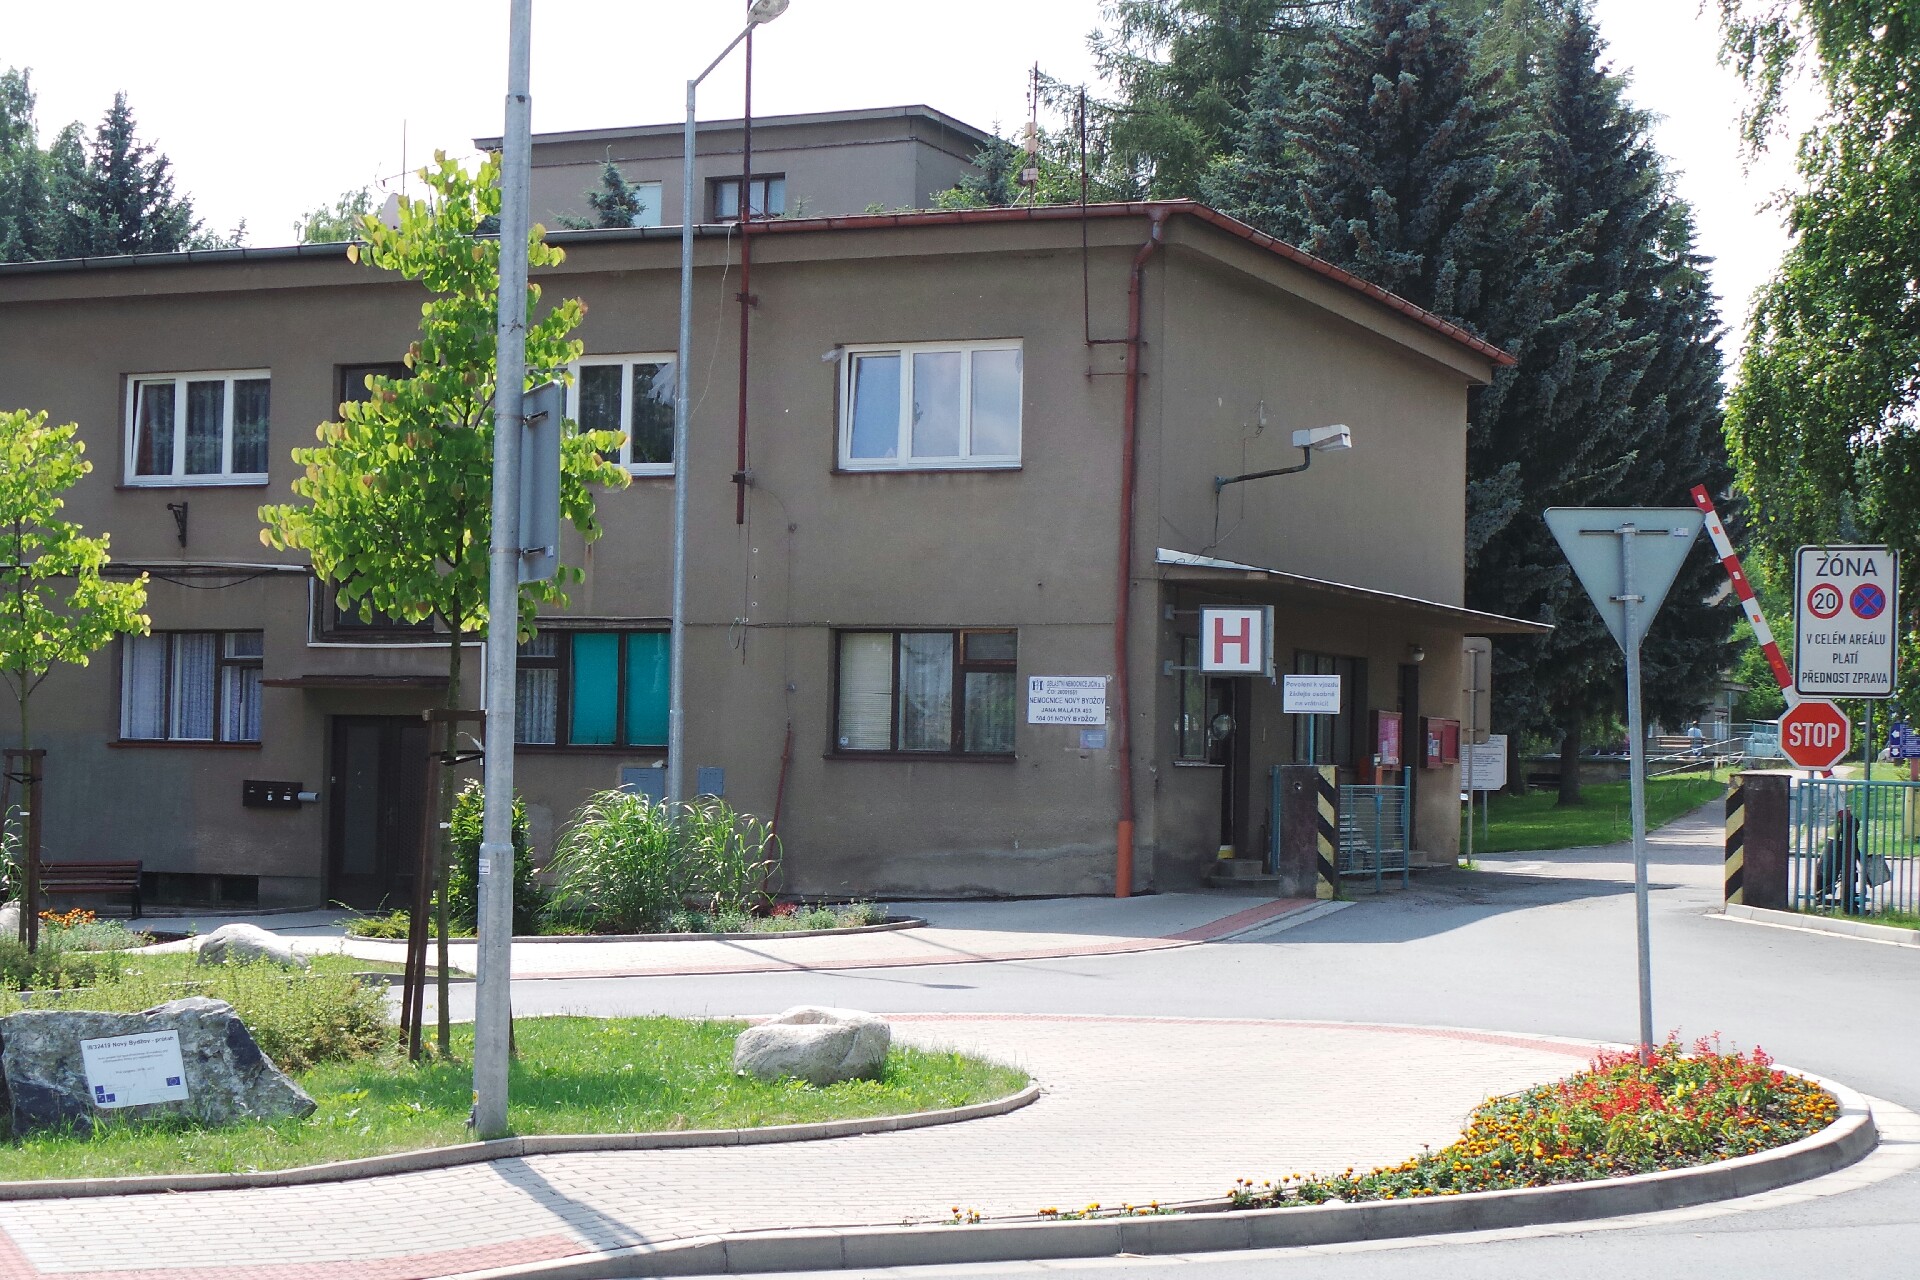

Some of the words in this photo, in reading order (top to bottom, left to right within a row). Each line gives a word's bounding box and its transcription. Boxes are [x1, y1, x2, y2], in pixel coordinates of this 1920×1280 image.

[1816, 553, 1878, 577] ZÓNA
[1814, 593, 1836, 609] 20
[1214, 617, 1250, 664] H
[1806, 633, 1812, 644] V
[1815, 631, 1846, 645] CELÉM
[1848, 631, 1886, 645] AREÁLU
[1832, 650, 1859, 664] PLATÍ
[1802, 669, 1850, 684] PŘEDNOST
[1852, 672, 1888, 684] ZPRAVA
[1081, 695, 1105, 704] BYDŽOV
[1789, 722, 1840, 748] STOP
